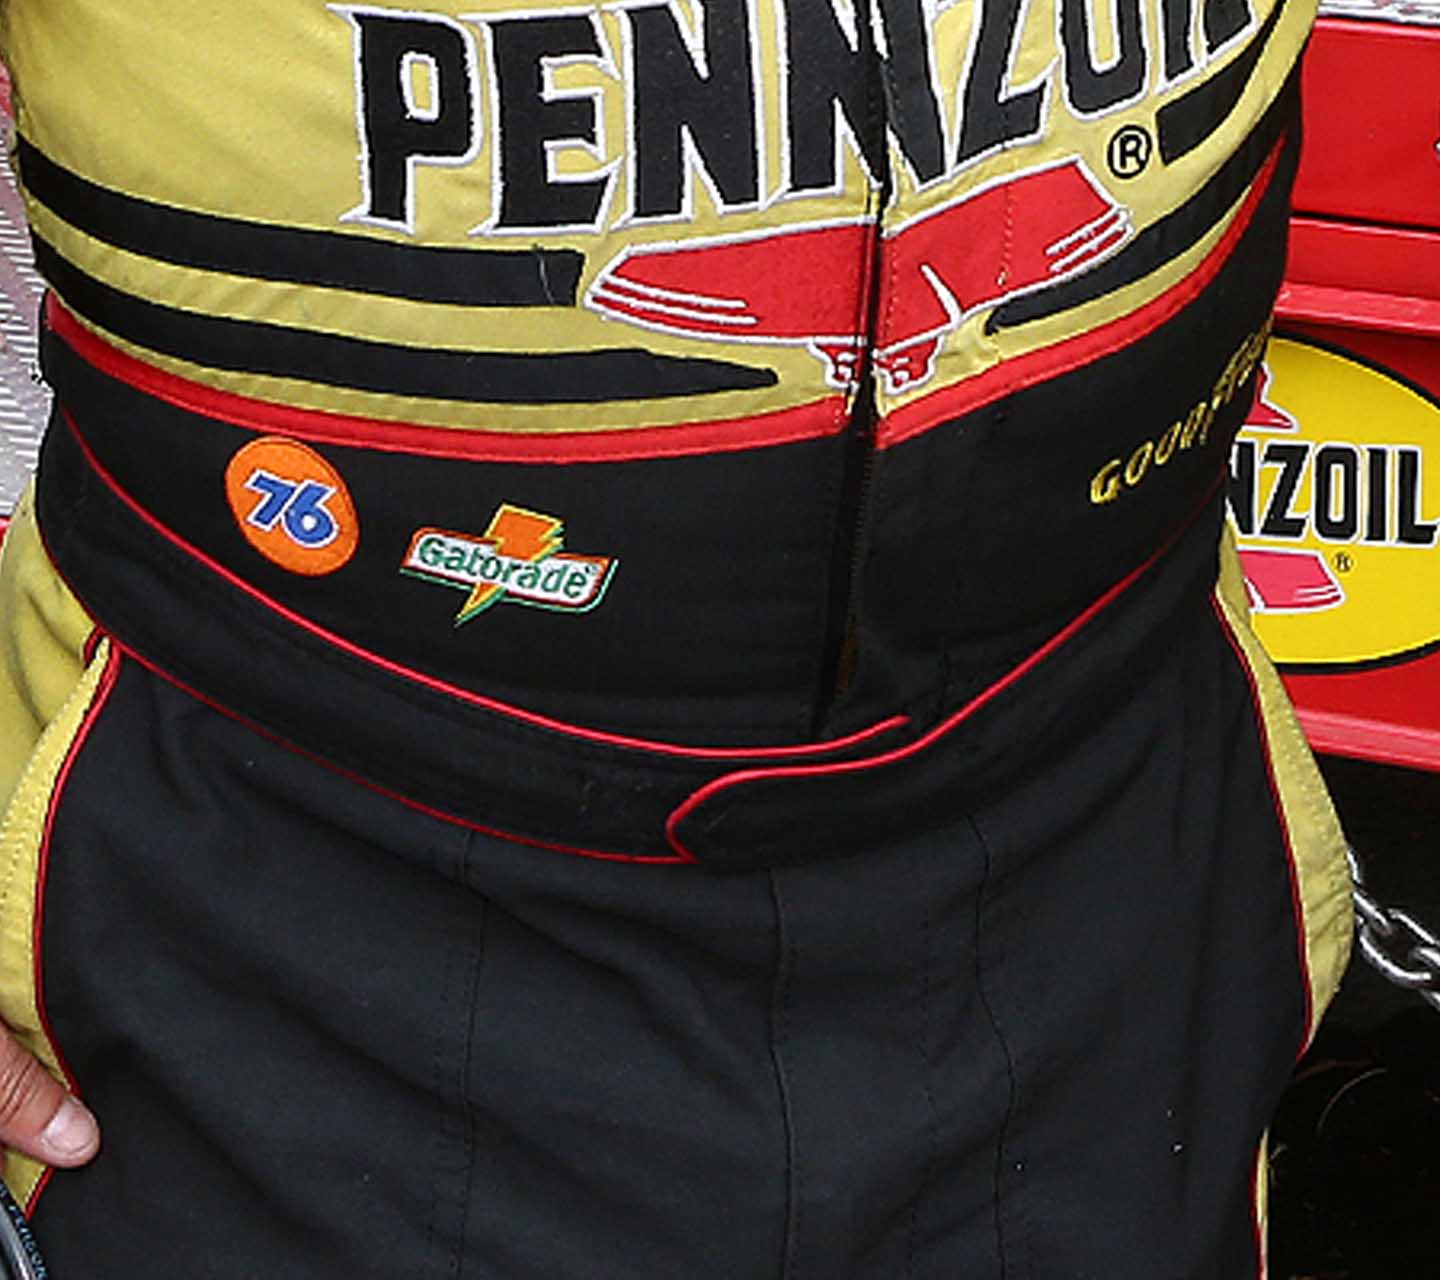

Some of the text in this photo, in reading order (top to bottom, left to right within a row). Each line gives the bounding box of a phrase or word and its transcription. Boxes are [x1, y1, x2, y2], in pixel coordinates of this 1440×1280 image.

[1090, 324, 1271, 505] GOOD
[244, 469, 340, 549] 76
[416, 535, 596, 600] Gatorade
